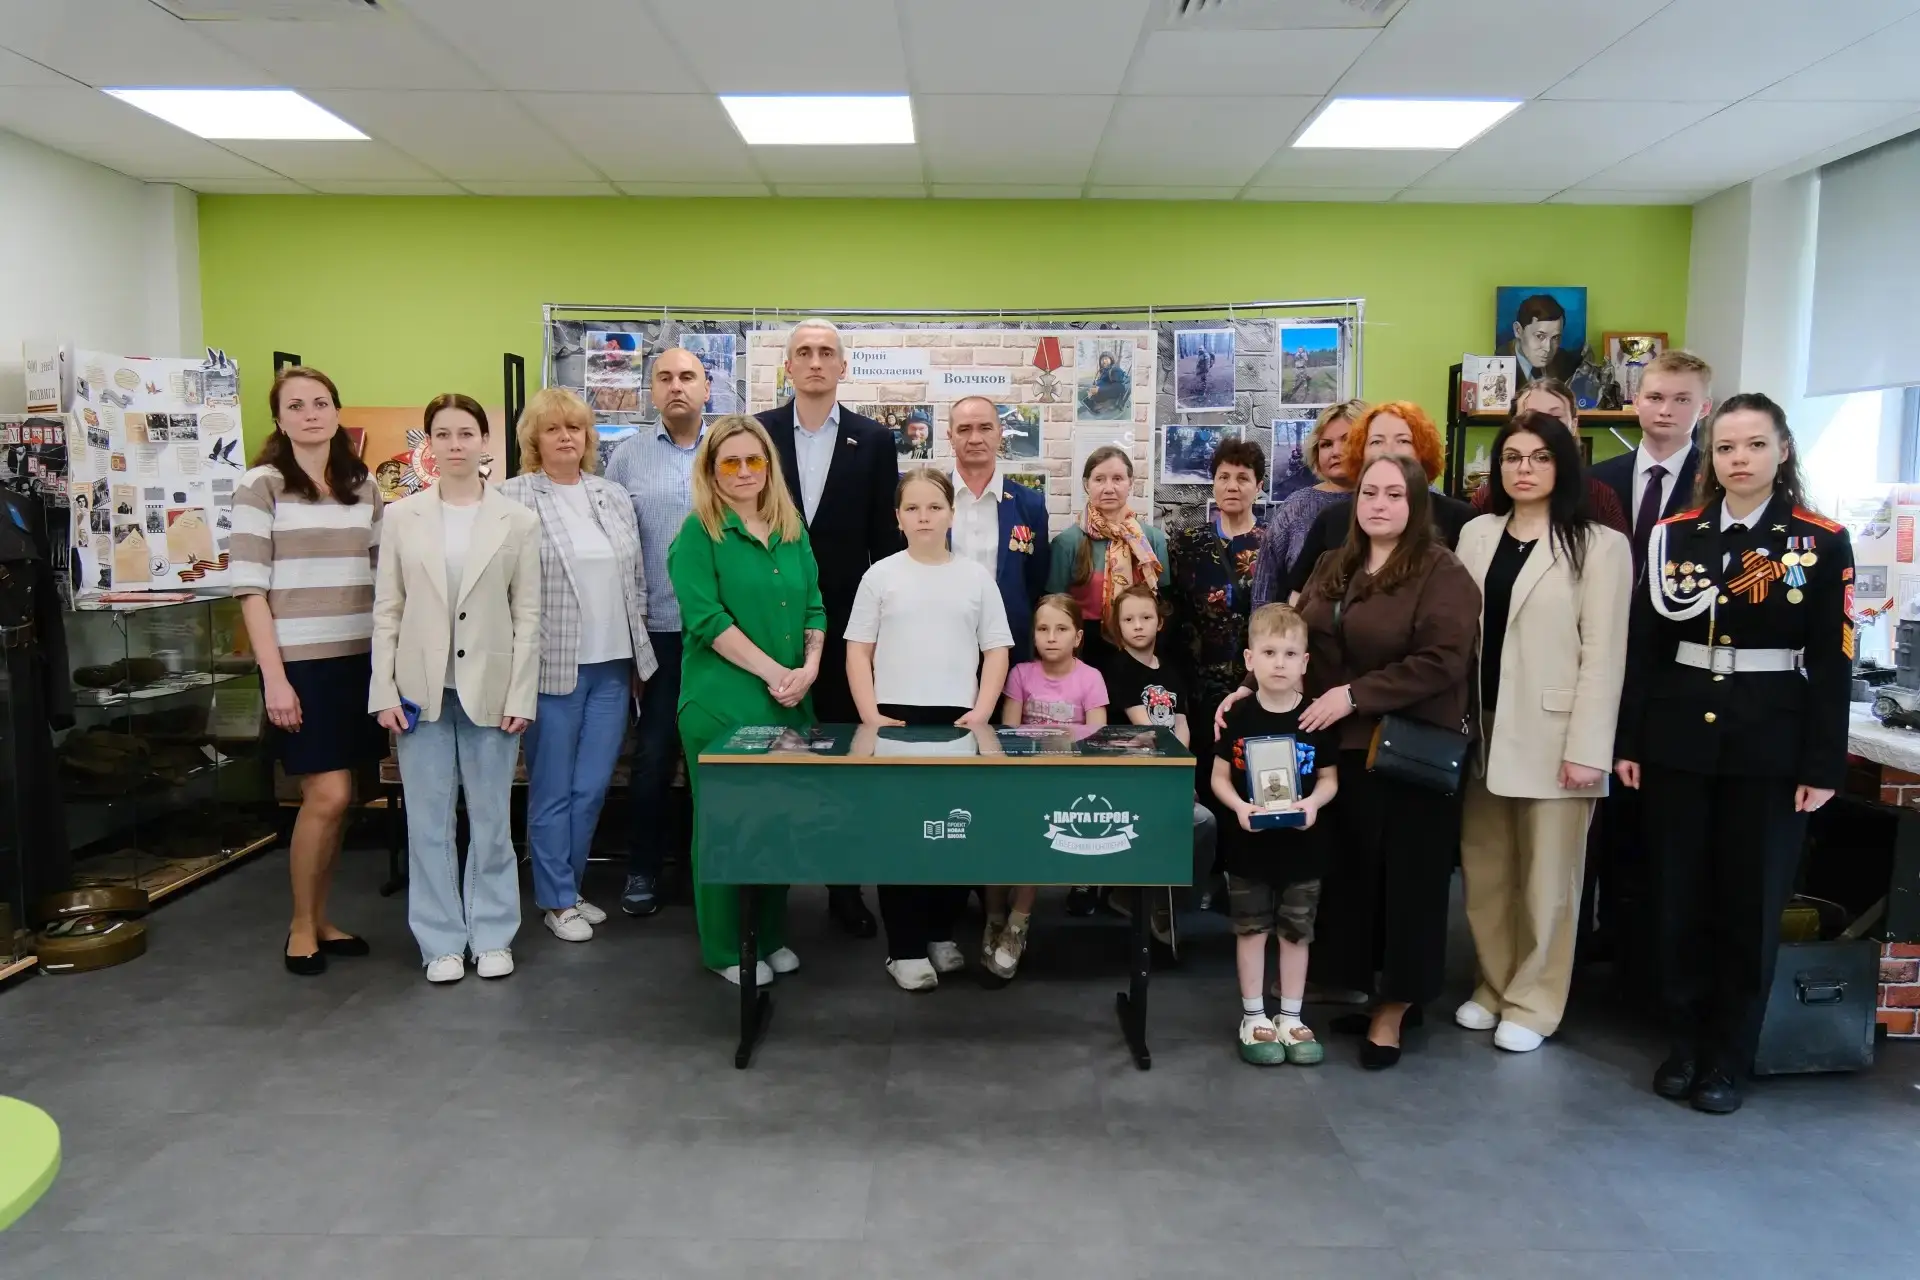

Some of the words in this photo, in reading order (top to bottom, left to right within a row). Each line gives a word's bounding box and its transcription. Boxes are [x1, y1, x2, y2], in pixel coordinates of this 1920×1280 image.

[852, 351, 887, 362] Юрий
[852, 366, 923, 376] Николаевич
[943, 372, 1006, 384] Волчков
[1053, 811, 1092, 824] ПАРТА
[1093, 811, 1130, 824] ГЕРОЯ
